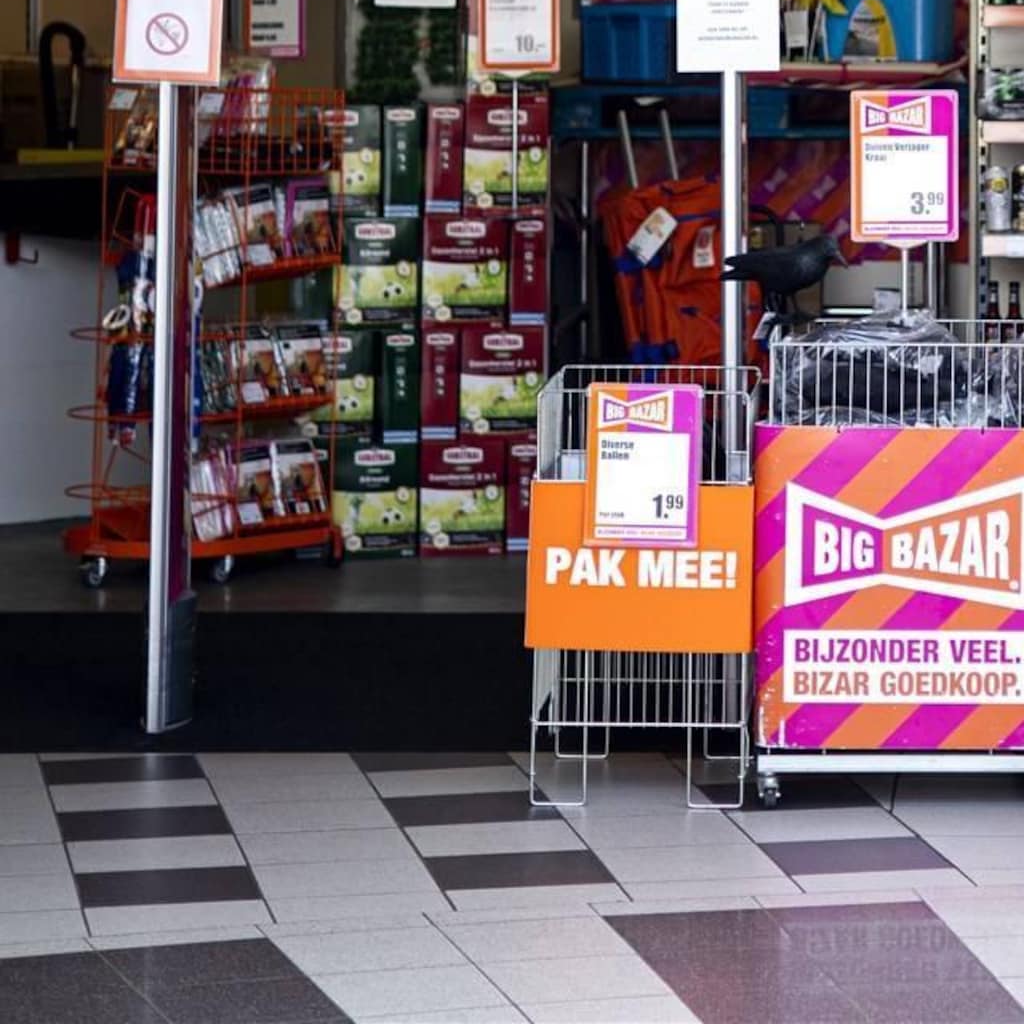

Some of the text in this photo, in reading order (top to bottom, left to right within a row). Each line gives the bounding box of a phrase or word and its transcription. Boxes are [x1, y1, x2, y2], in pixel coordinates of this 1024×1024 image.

[868, 104, 925, 127] BIG BAZAR
[605, 400, 666, 425] BIG BAZAR
[601, 439, 635, 450] Diverse
[601, 450, 630, 461] Ballen
[652, 493, 685, 519] 1.99
[814, 509, 1010, 581] BIG BAZAR
[545, 547, 738, 589] PAK MEE!
[794, 638, 1022, 664] BIJZONDER VEEL.
[793, 671, 1022, 697] BIZAR GOEDKOOP.
